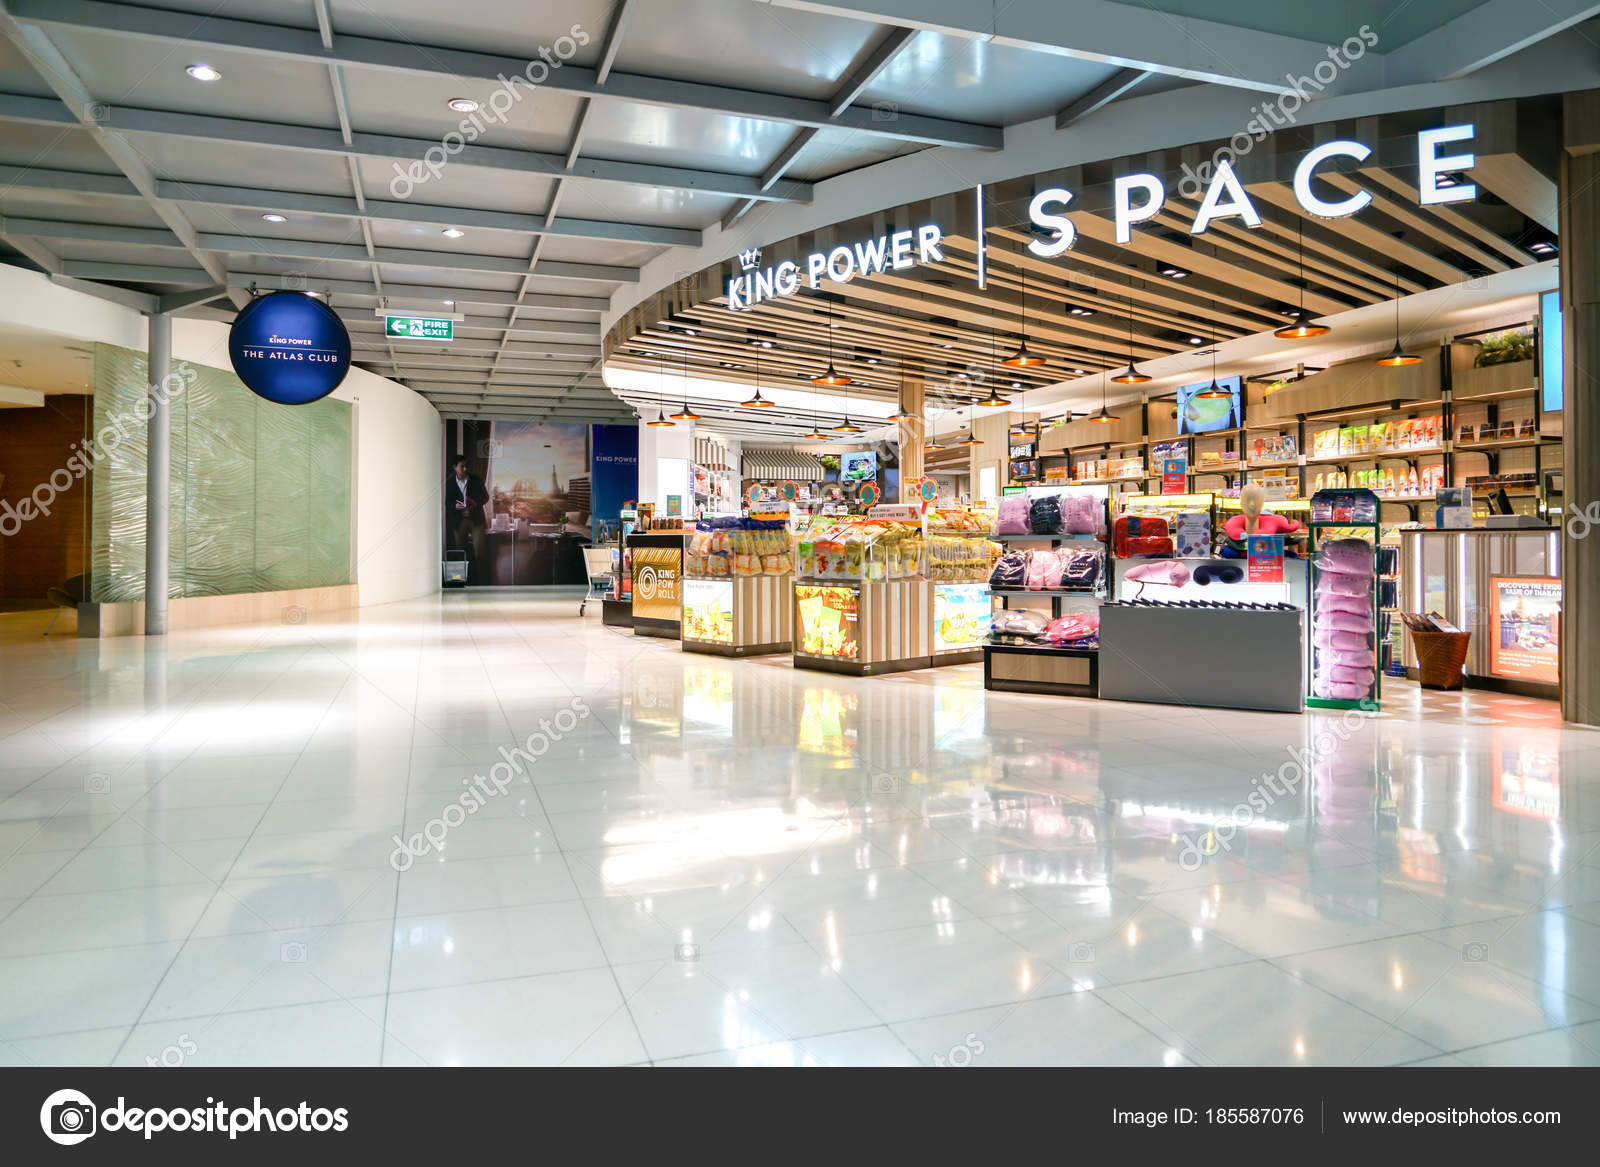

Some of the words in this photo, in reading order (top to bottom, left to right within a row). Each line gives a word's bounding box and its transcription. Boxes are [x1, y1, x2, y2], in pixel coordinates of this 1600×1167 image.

[728, 261, 799, 310] KING
[808, 224, 945, 290] POWER
[1027, 124, 1477, 258] SPACE
[424, 328, 448, 336] EXIT
[288, 338, 312, 346] POWER
[243, 350, 264, 359] THE
[269, 352, 303, 361] ATLAS
[308, 354, 338, 363] CLUB
[658, 569, 675, 579] KING
[658, 579, 673, 589] POW
[658, 590, 675, 600] ROLL
